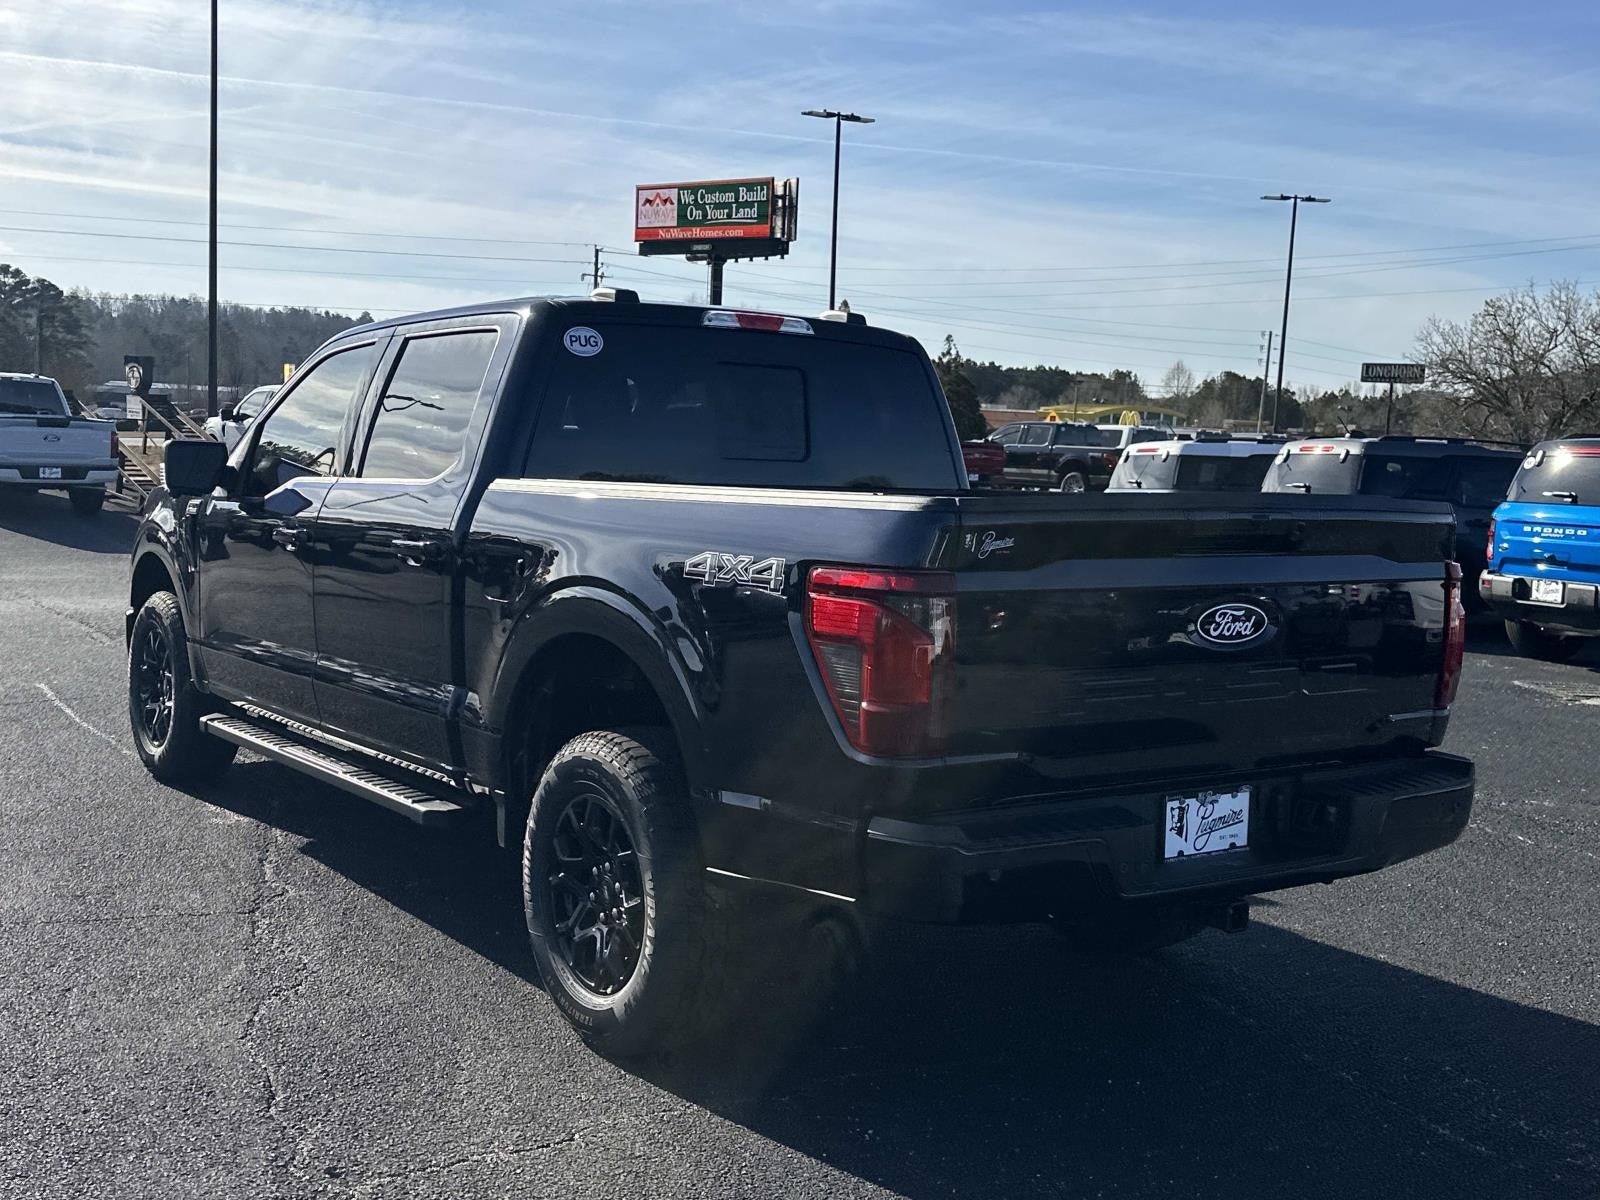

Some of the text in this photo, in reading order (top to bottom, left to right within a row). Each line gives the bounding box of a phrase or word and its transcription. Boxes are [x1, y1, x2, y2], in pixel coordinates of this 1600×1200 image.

[680, 185, 767, 204] We Custom Build
[687, 203, 758, 220] On Your Land
[658, 228, 744, 239] NuWaveHomes.com
[569, 334, 598, 347] PUG
[1363, 364, 1421, 379] LONGHORN
[1523, 525, 1588, 536] BRONCO
[1210, 609, 1256, 637] Ford
[1193, 802, 1244, 851] Pugmire
